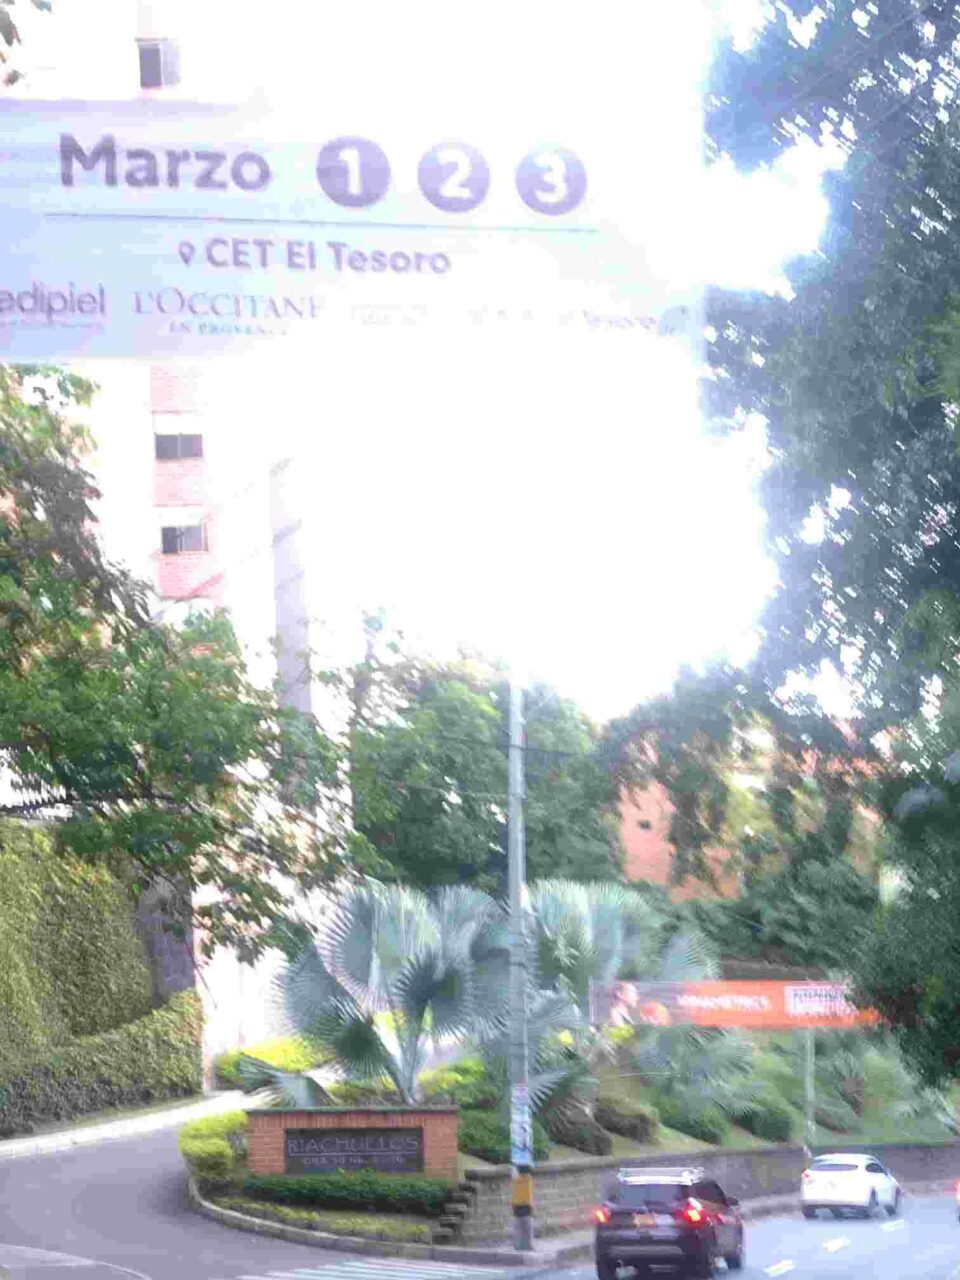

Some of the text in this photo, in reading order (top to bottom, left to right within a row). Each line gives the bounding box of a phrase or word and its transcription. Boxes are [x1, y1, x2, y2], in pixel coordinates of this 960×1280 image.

[60, 134, 271, 191] Marzo
[207, 238, 450, 274] CET El Tesoro
